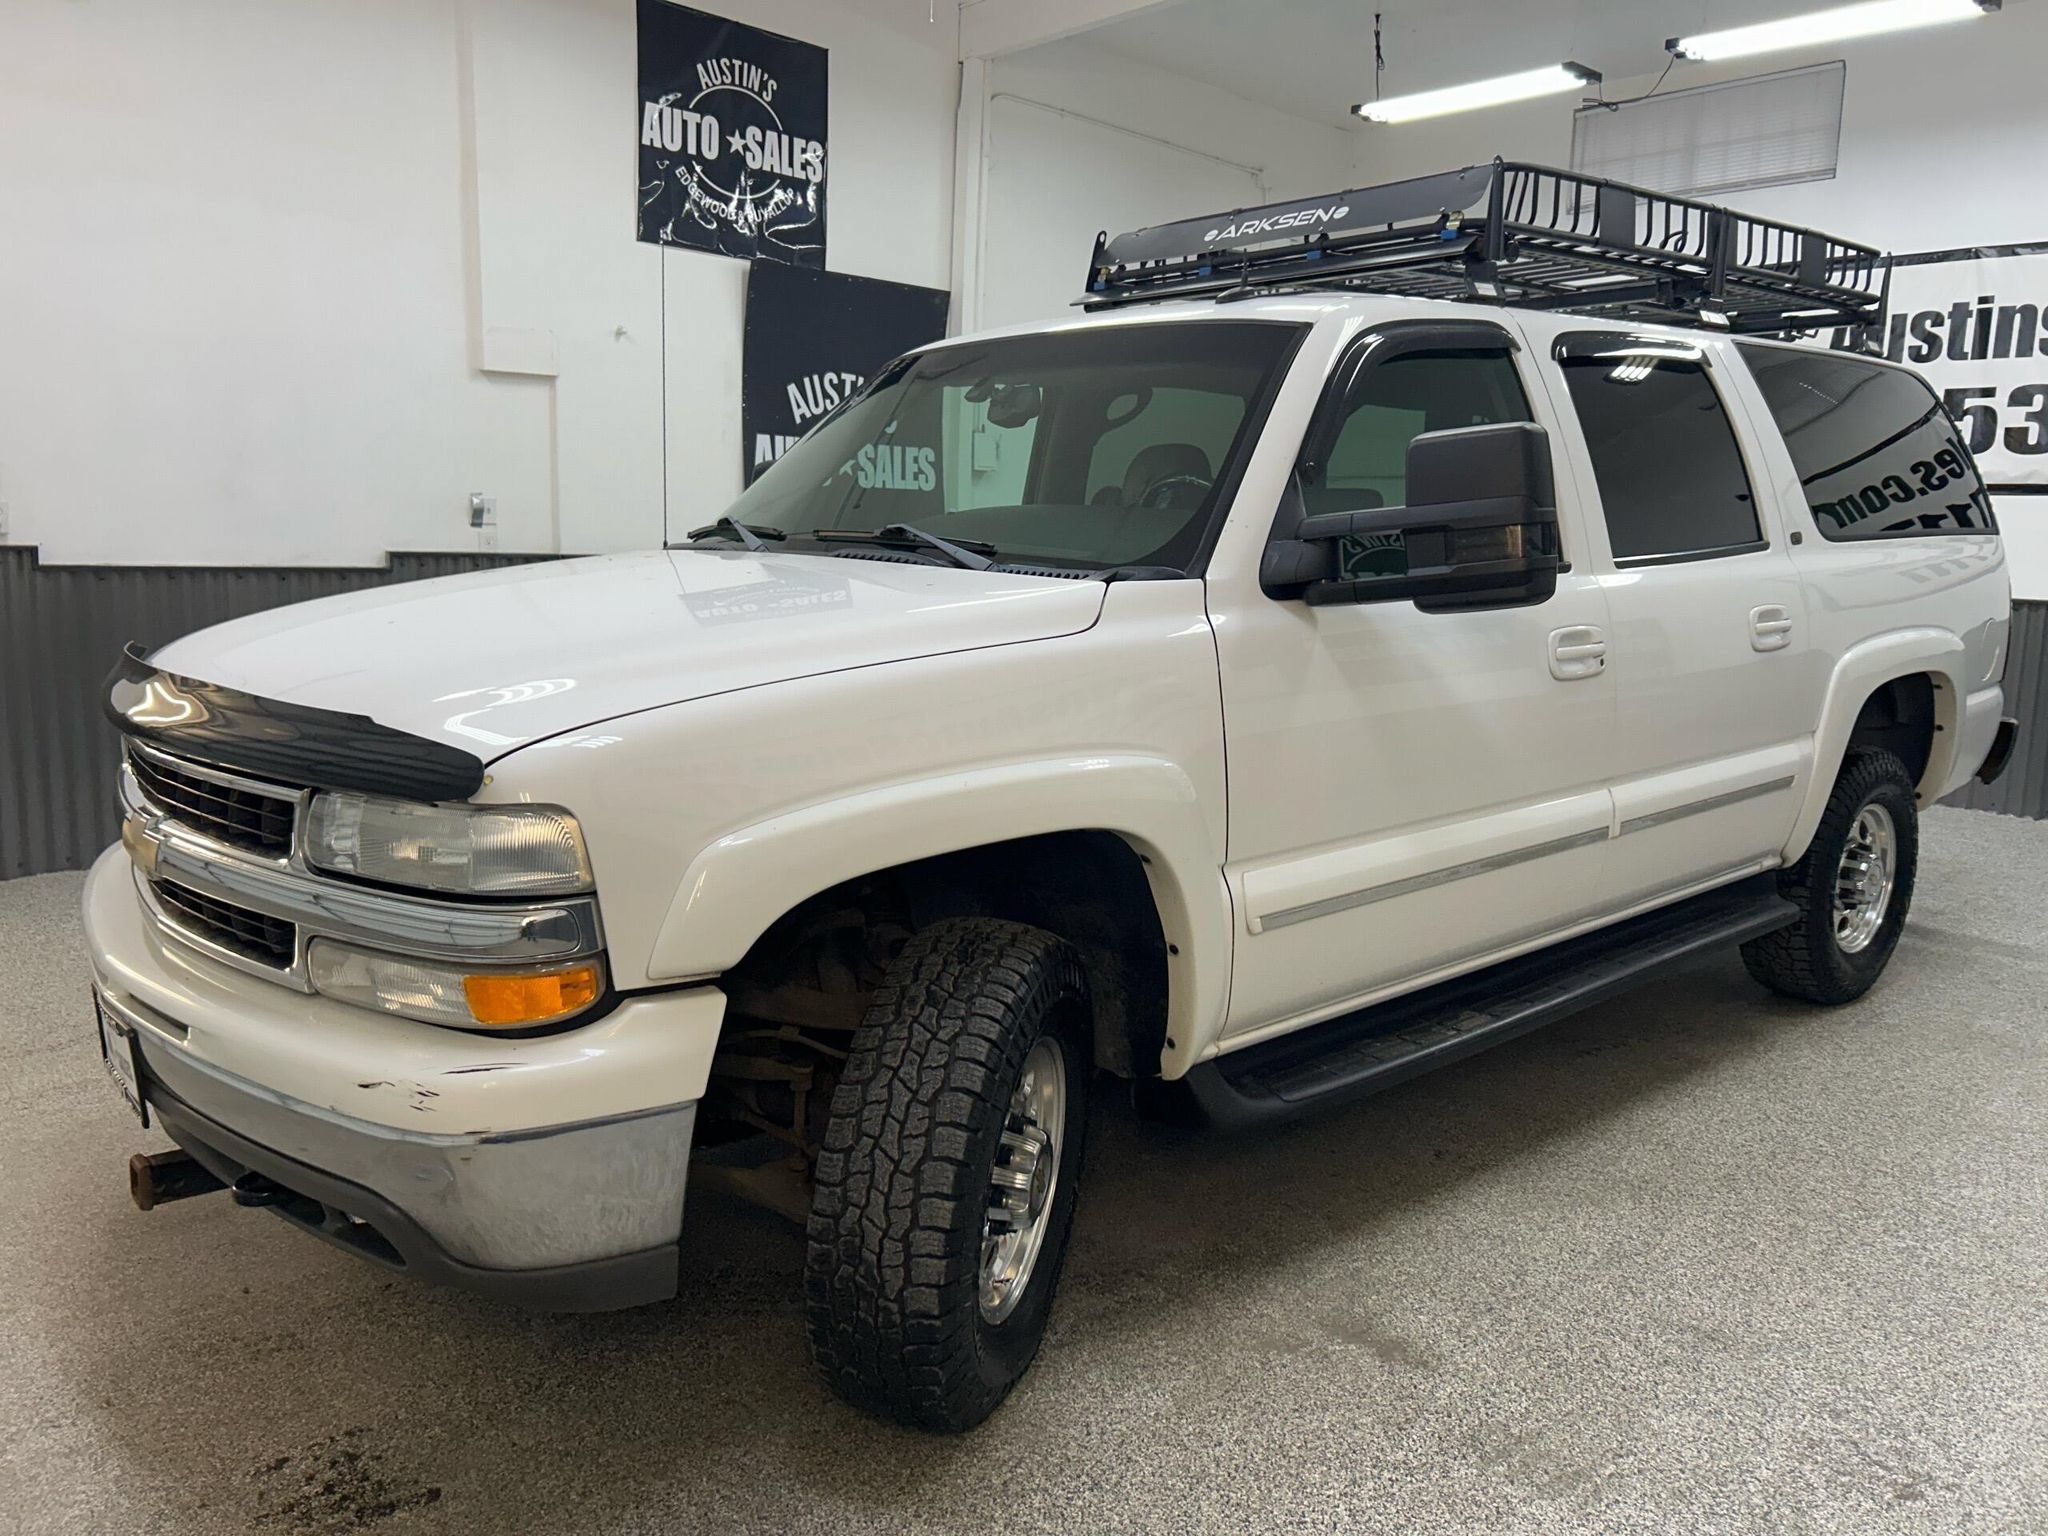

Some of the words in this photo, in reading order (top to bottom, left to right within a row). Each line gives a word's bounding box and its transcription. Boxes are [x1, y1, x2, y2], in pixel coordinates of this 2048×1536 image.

[696, 57, 777, 102] AUSTIN'S
[642, 101, 720, 160] AUTO
[745, 126, 823, 183] SALES
[1215, 206, 1337, 241] ARKSEN
[786, 371, 865, 425] AUST
[857, 442, 936, 492] SALES
